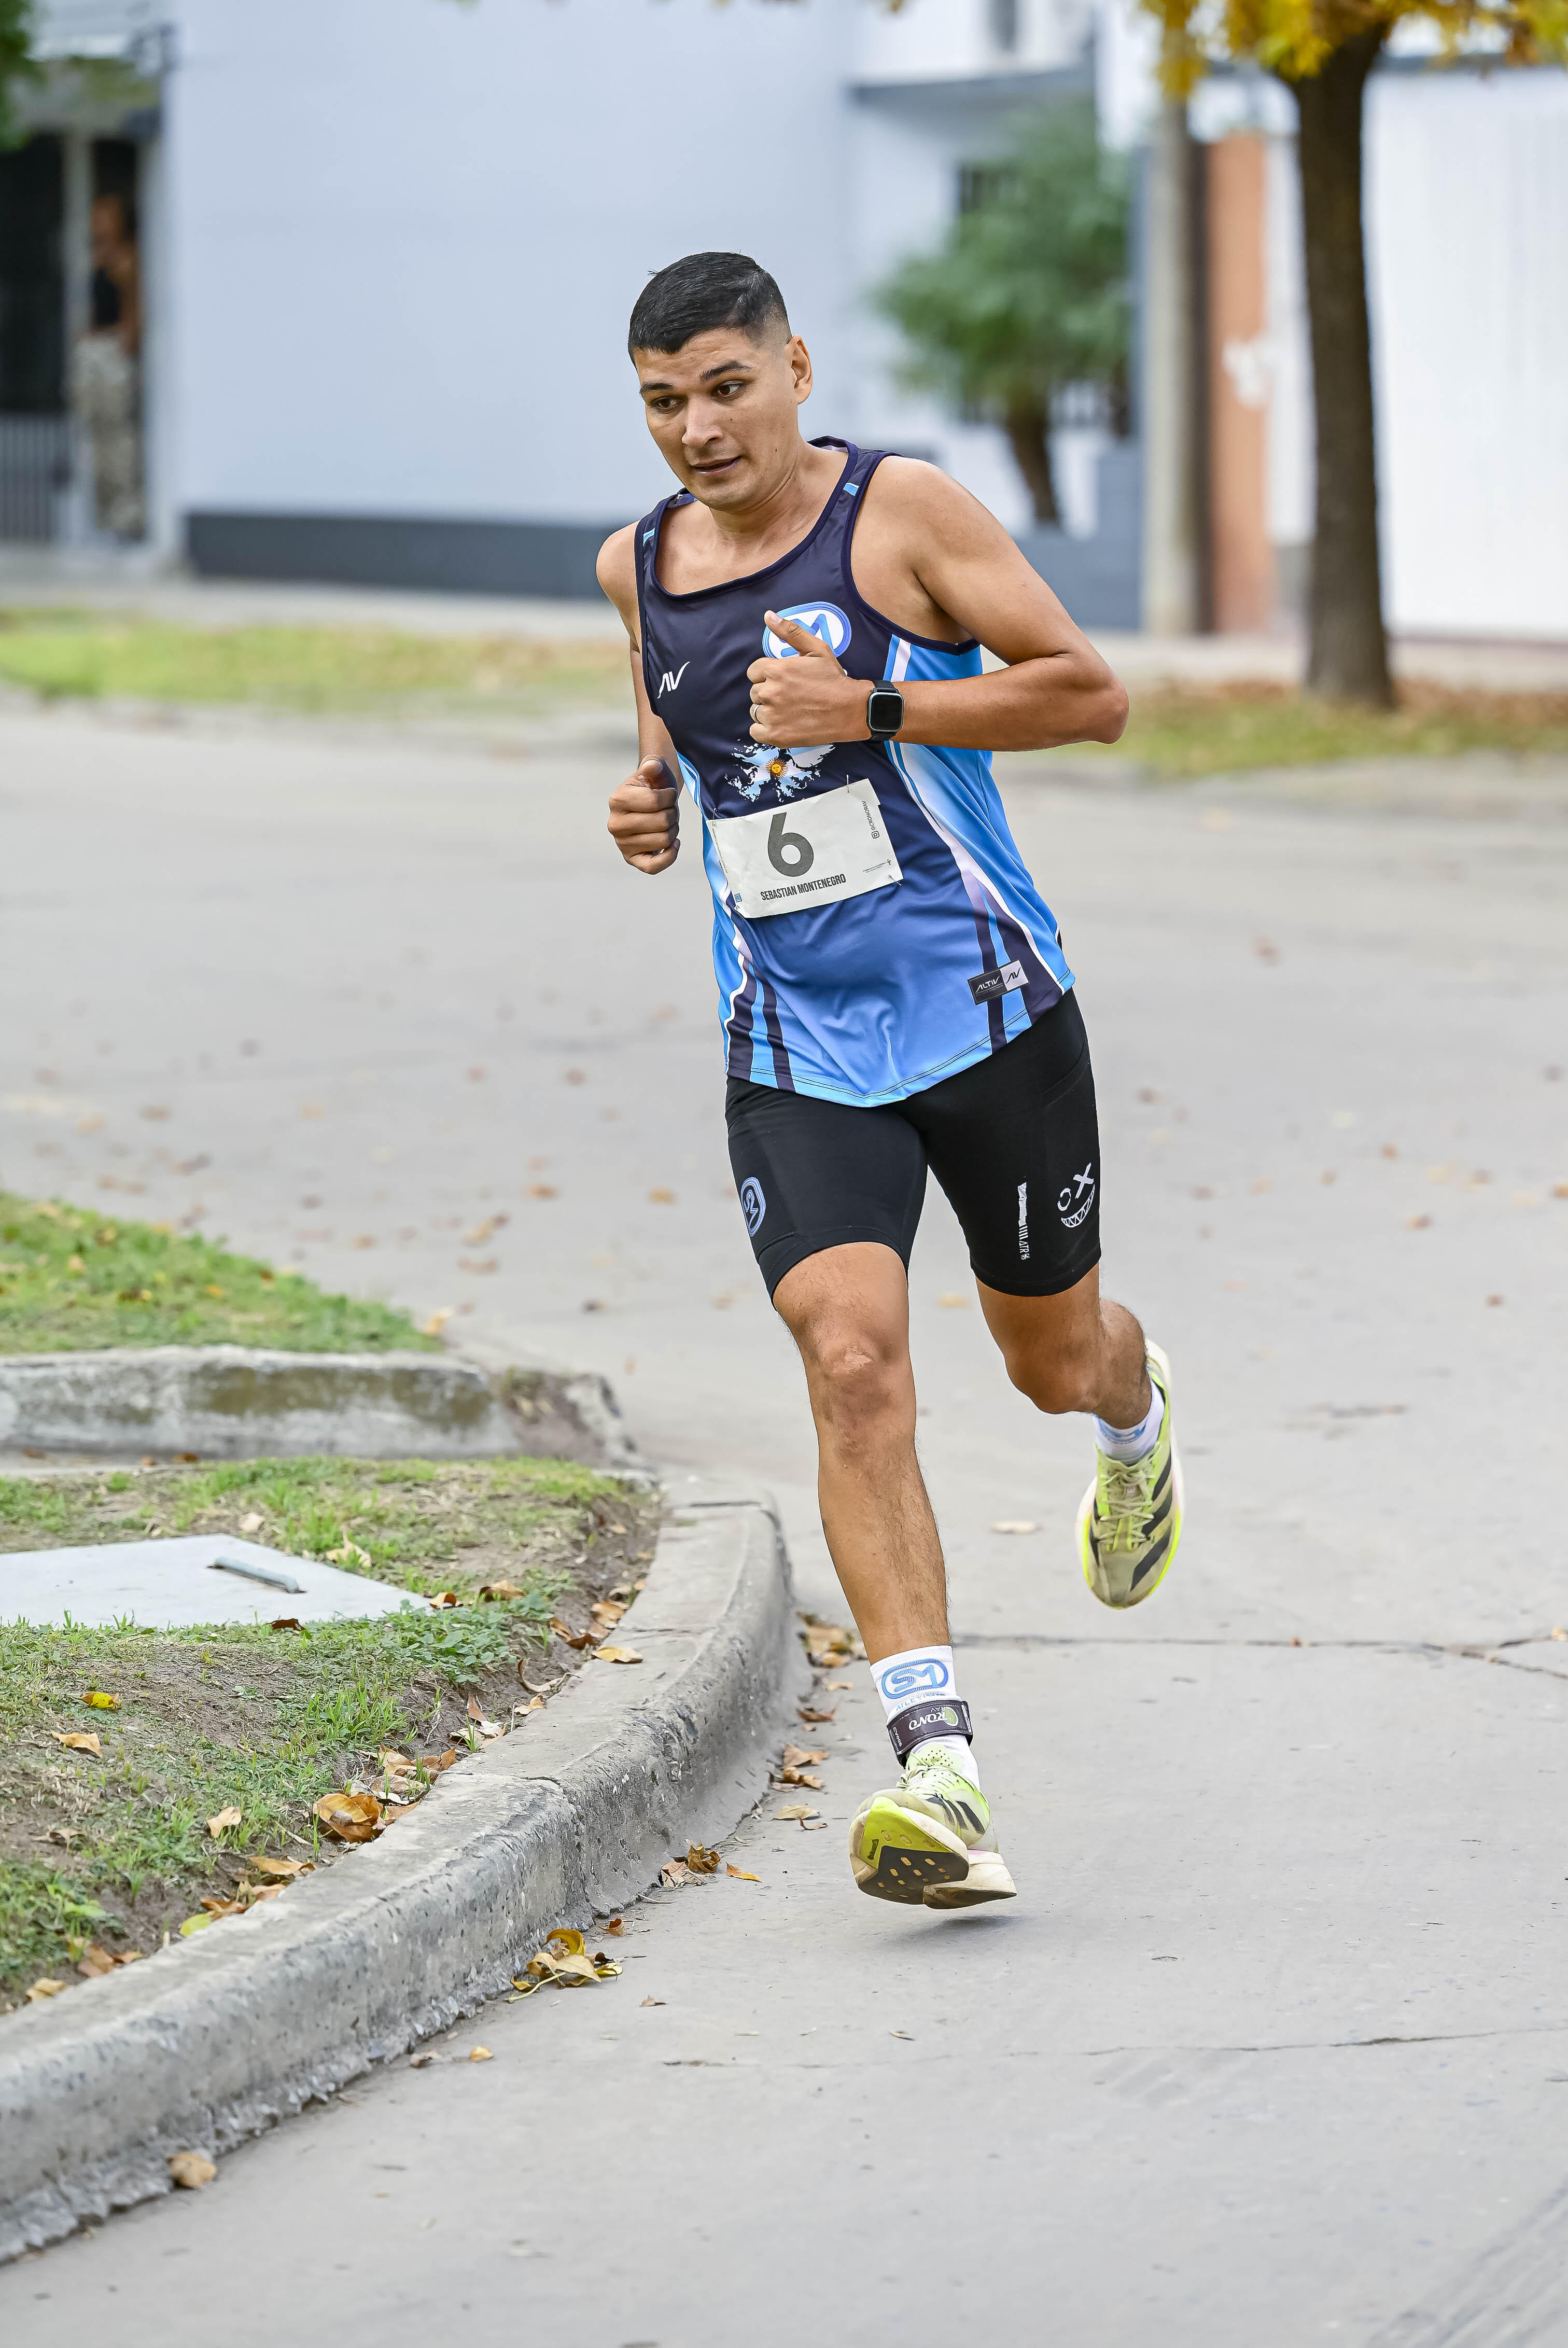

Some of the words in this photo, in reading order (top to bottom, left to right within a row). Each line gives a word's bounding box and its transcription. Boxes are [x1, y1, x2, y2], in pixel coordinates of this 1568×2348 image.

[862, 801, 876, 831] @CRONORAV
[767, 812, 814, 877] 6
[760, 886, 798, 901] SEBASTIAN
[797, 874, 846, 898] MONTENEGRO
